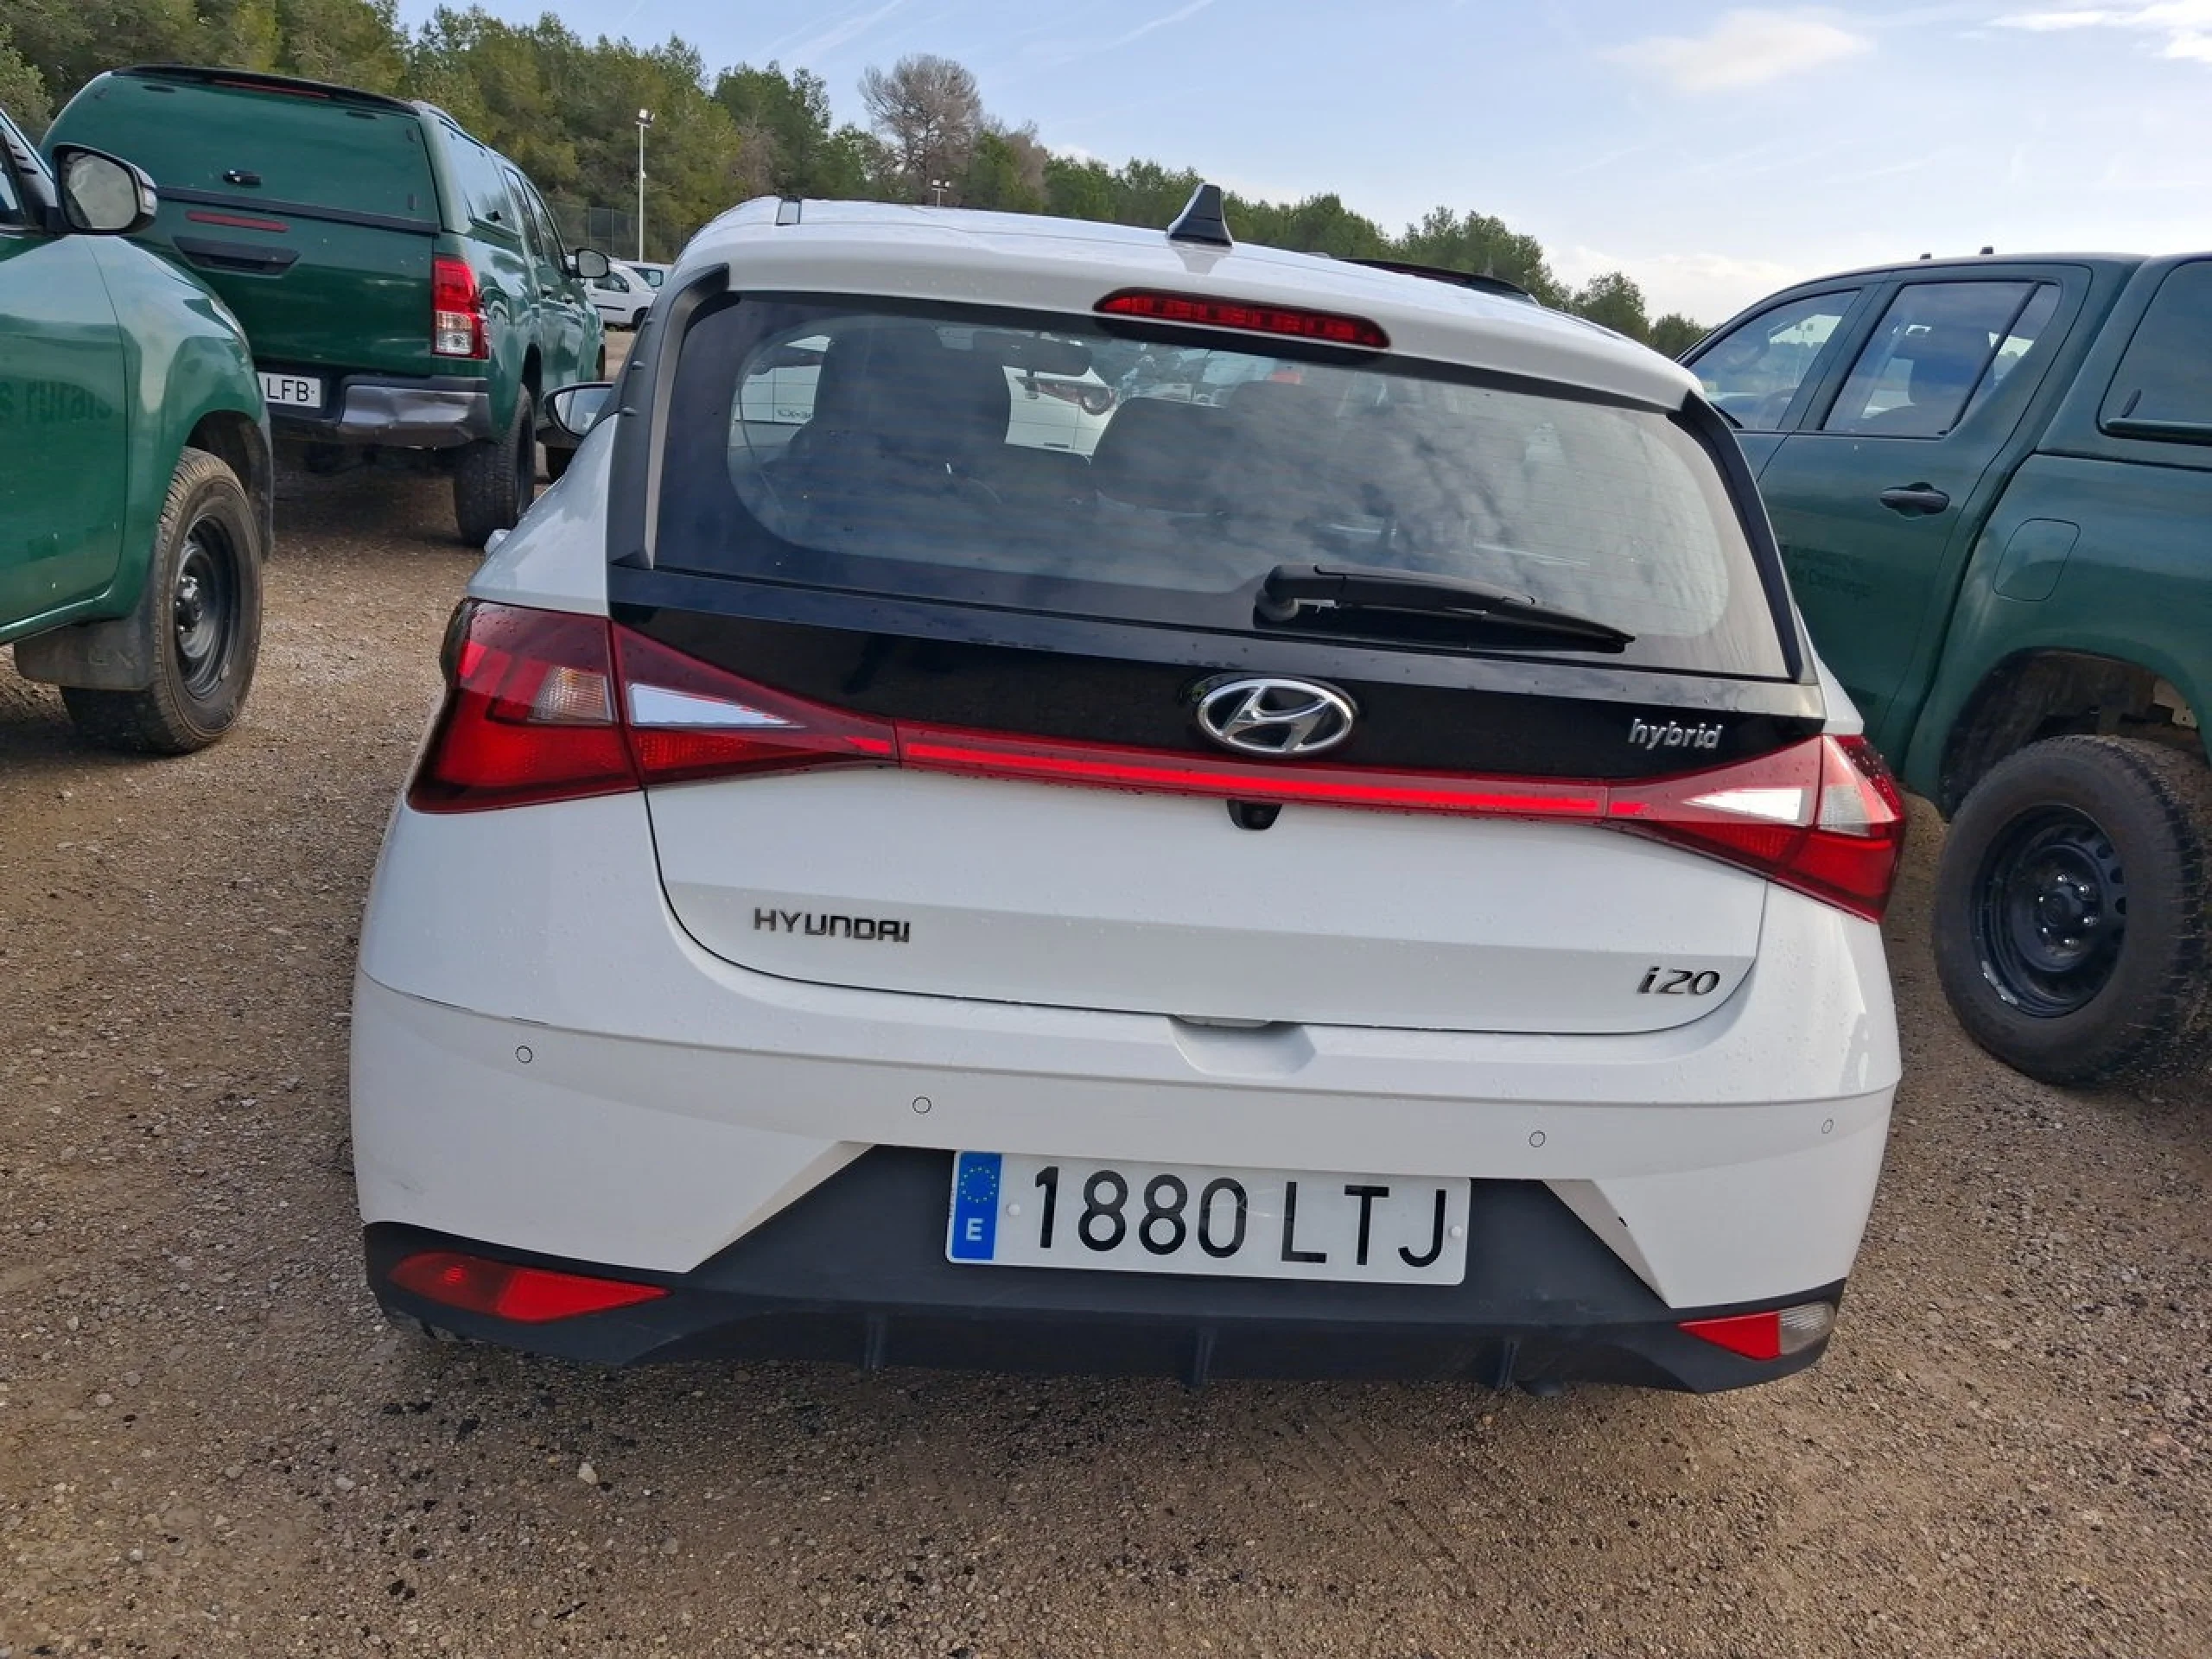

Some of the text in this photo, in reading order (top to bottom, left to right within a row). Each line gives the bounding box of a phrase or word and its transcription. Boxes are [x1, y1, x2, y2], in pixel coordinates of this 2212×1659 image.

[266, 377, 309, 403] LFB
[1628, 718, 1723, 750] hybrid
[753, 906, 911, 944] HYUNDAI
[1637, 965, 1720, 995] i20
[965, 1217, 983, 1241] E
[1034, 1166, 1447, 1268] 1880 LTJ
